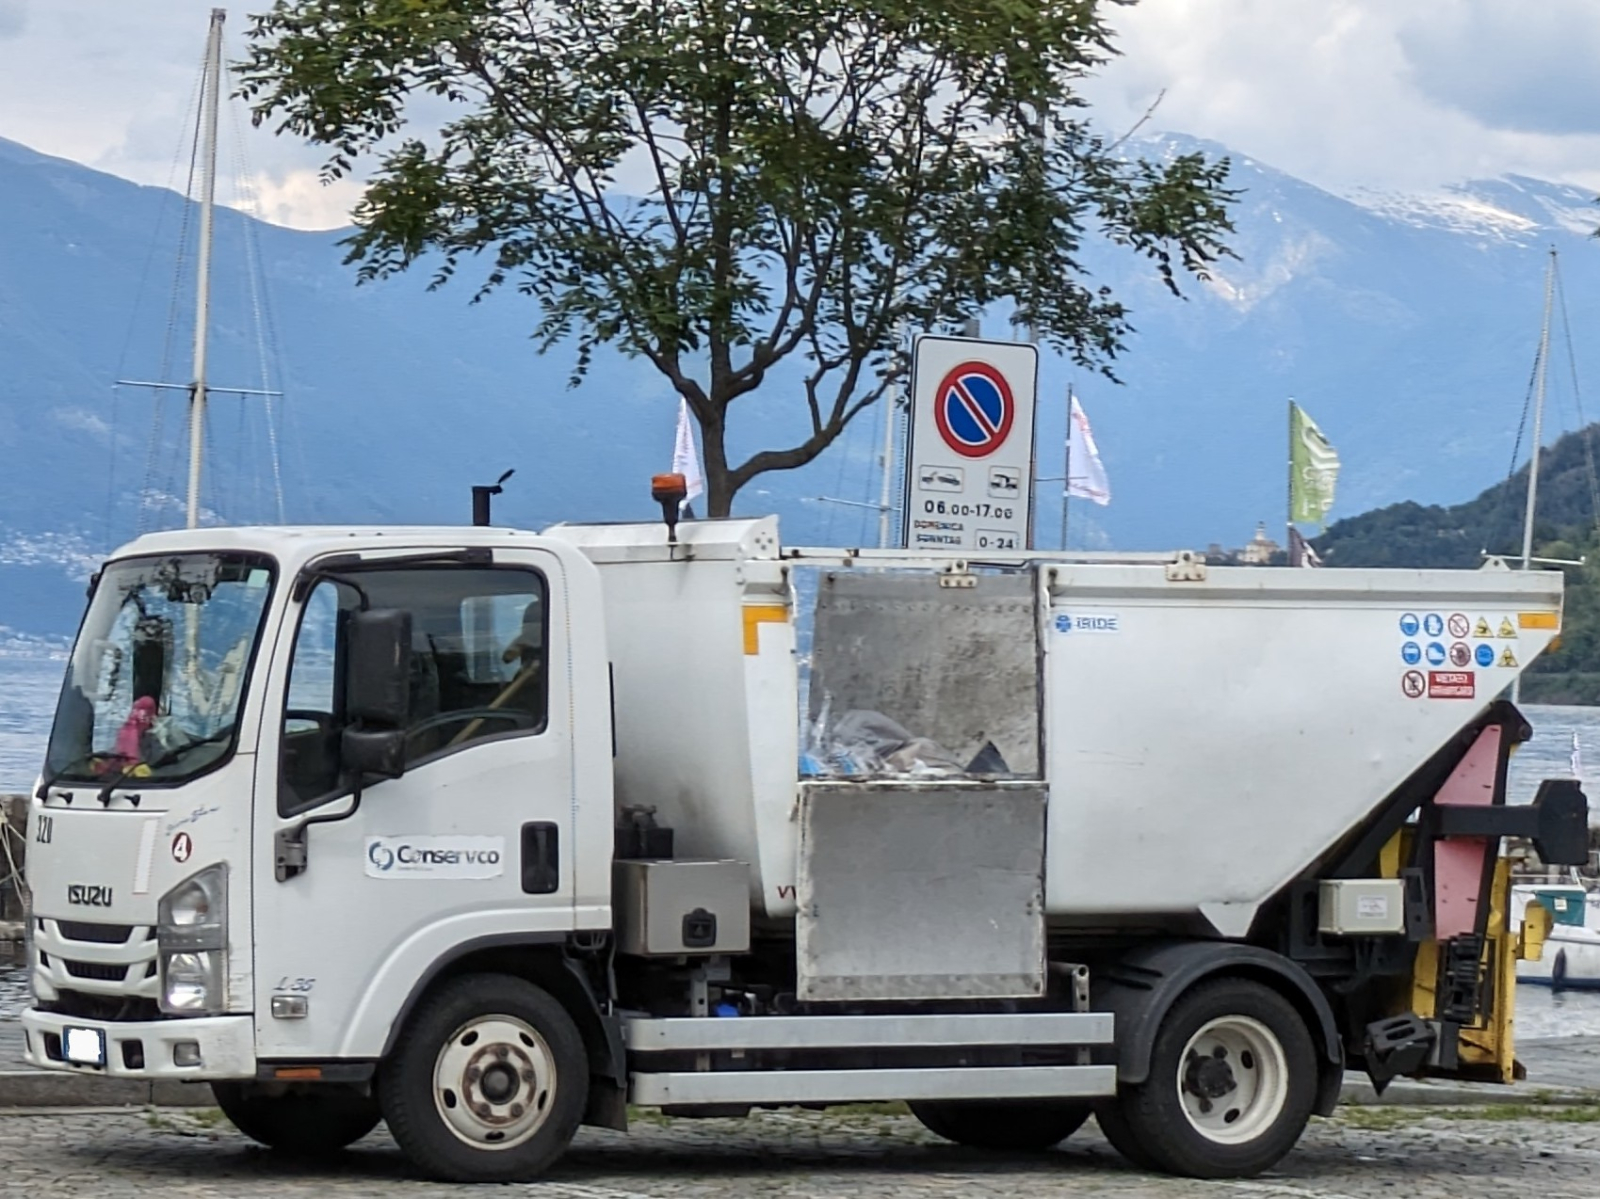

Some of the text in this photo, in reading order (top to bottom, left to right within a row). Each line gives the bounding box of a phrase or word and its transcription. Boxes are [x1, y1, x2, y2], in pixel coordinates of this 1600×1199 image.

[924, 499, 1013, 519] 06.00-17.00
[173, 834, 188, 862] 4
[397, 845, 500, 864] Conservco
[68, 885, 112, 907] ISUZU
